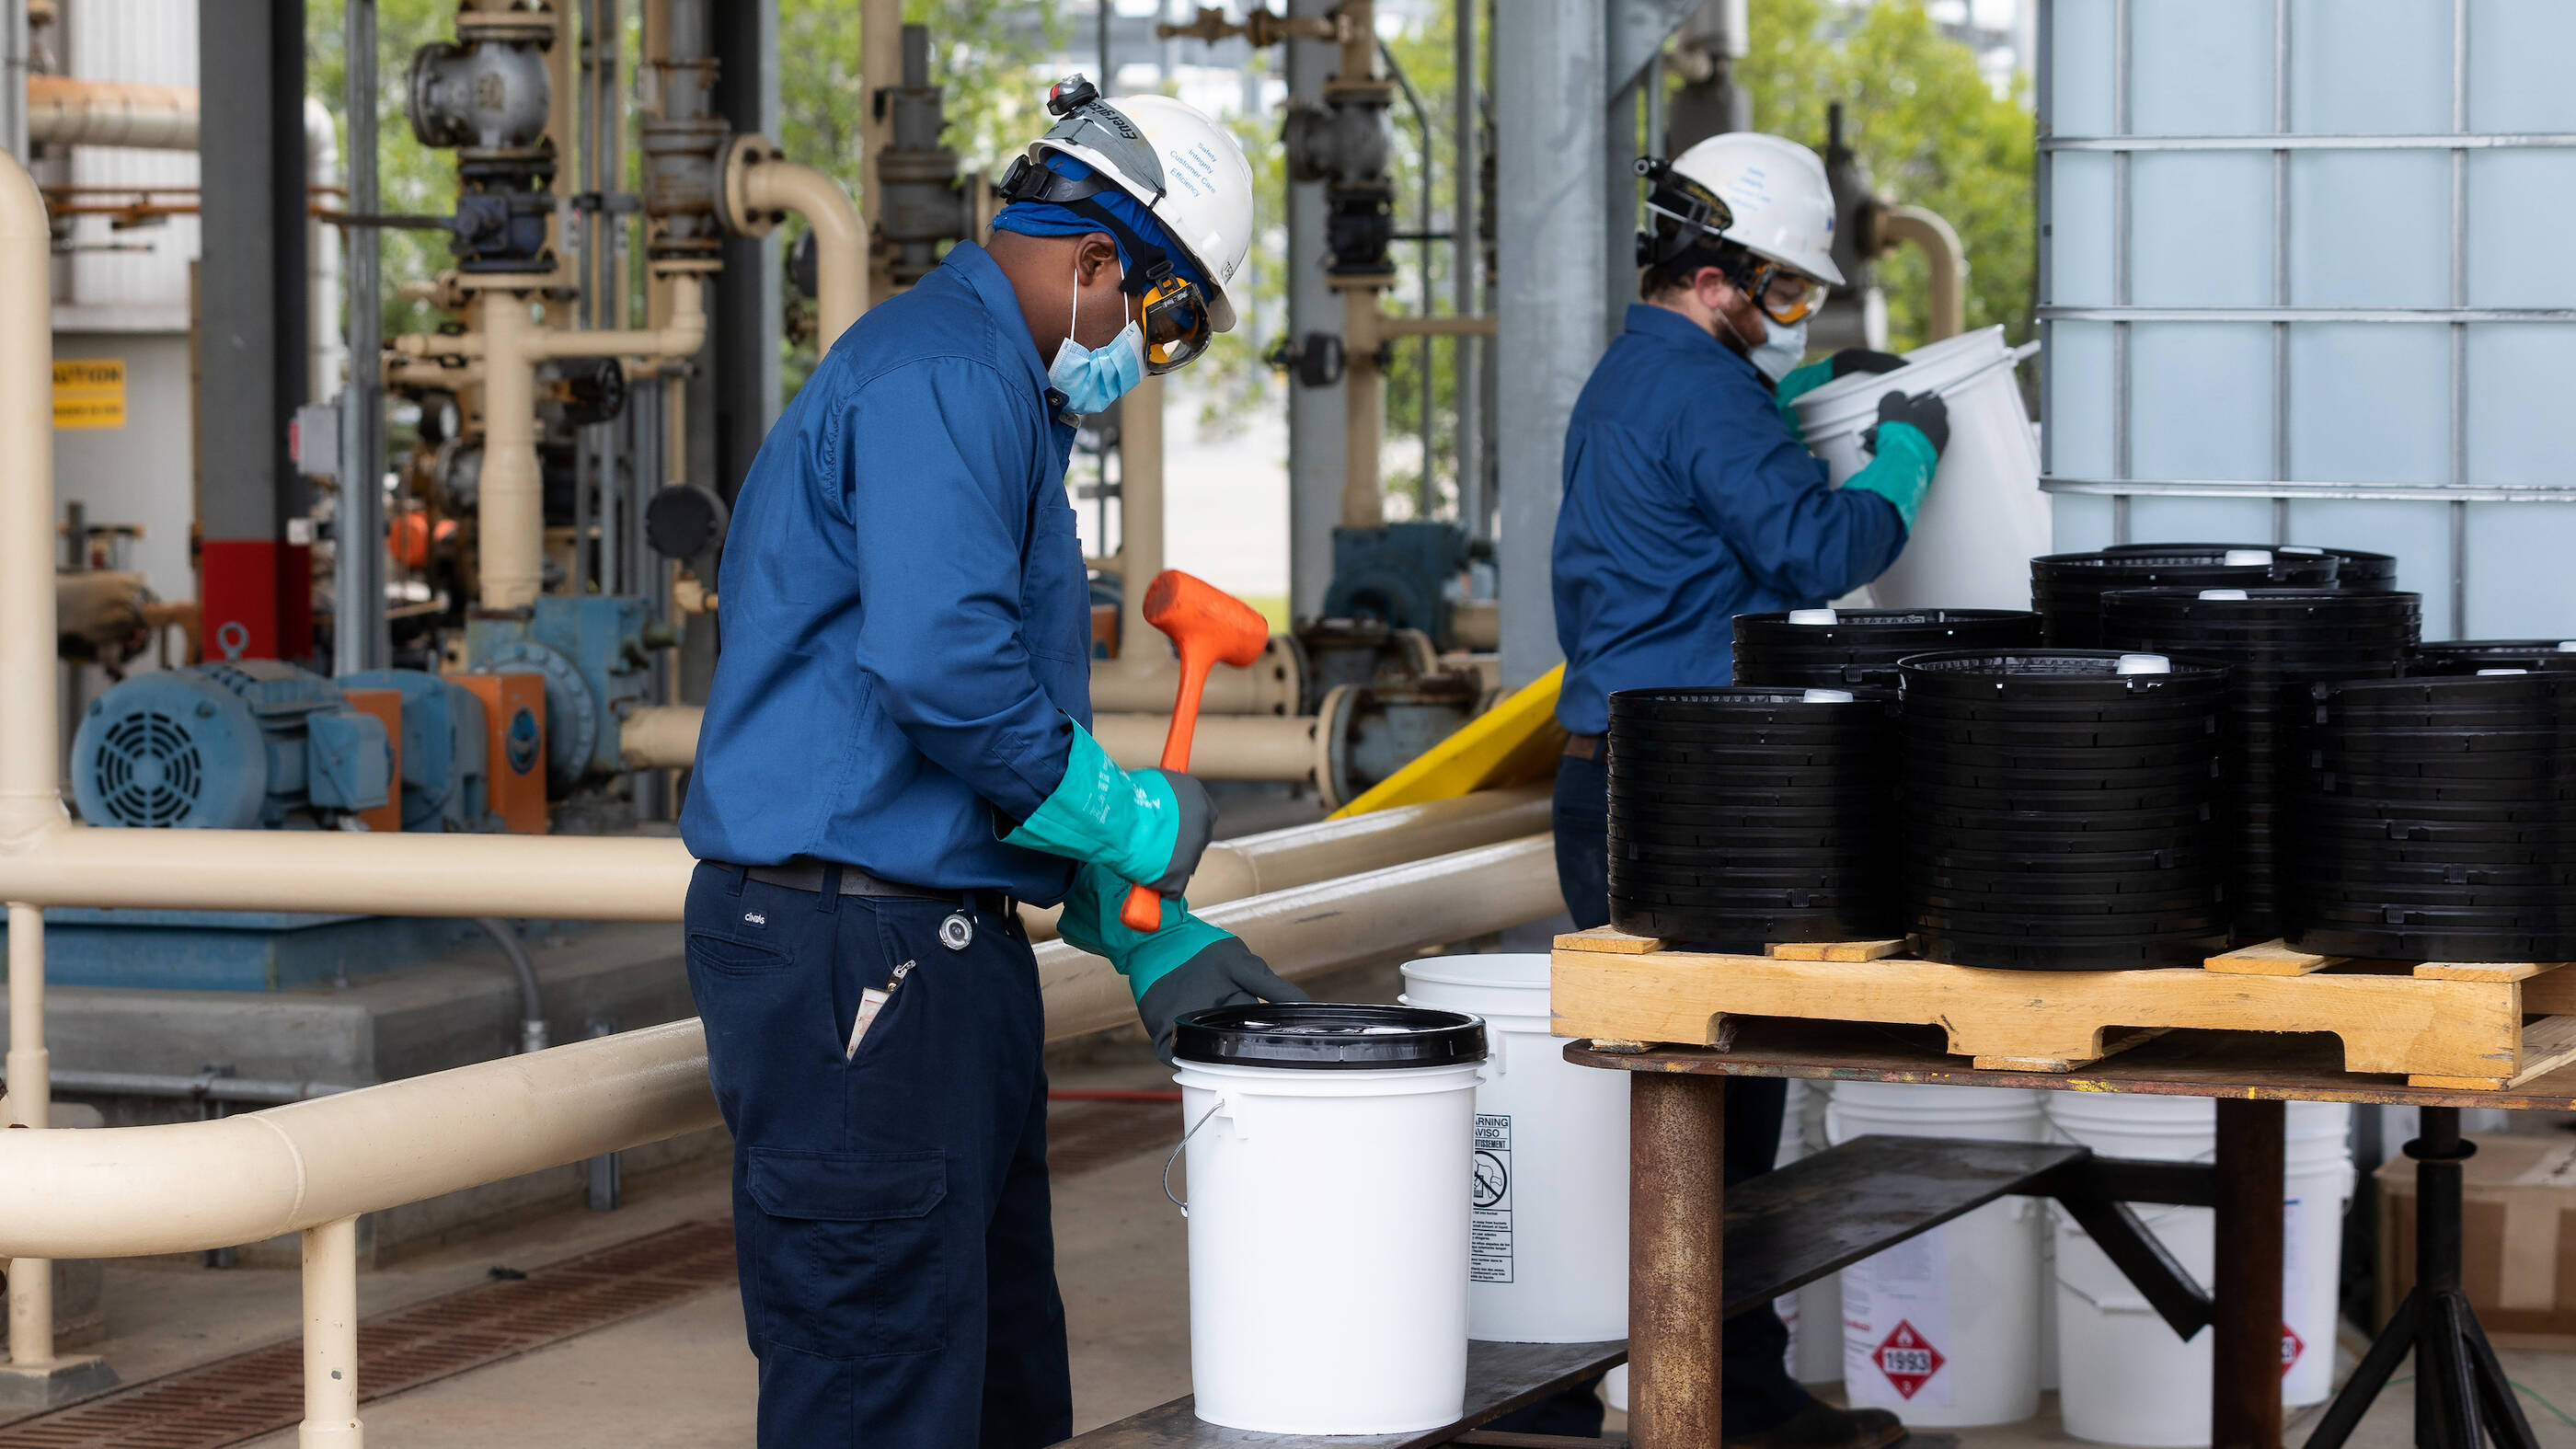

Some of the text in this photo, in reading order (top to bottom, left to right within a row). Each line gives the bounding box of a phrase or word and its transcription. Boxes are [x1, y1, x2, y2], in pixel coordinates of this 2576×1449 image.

[1087, 101, 1138, 140] Energize
[1189, 148, 1213, 174] Integrity
[1198, 142, 1216, 162] Safety
[1170, 150, 1215, 194] Customer Care
[1170, 167, 1200, 198] Efficiency
[1475, 1117, 1509, 1127] RNING
[1887, 1351, 1929, 1370] 1993
